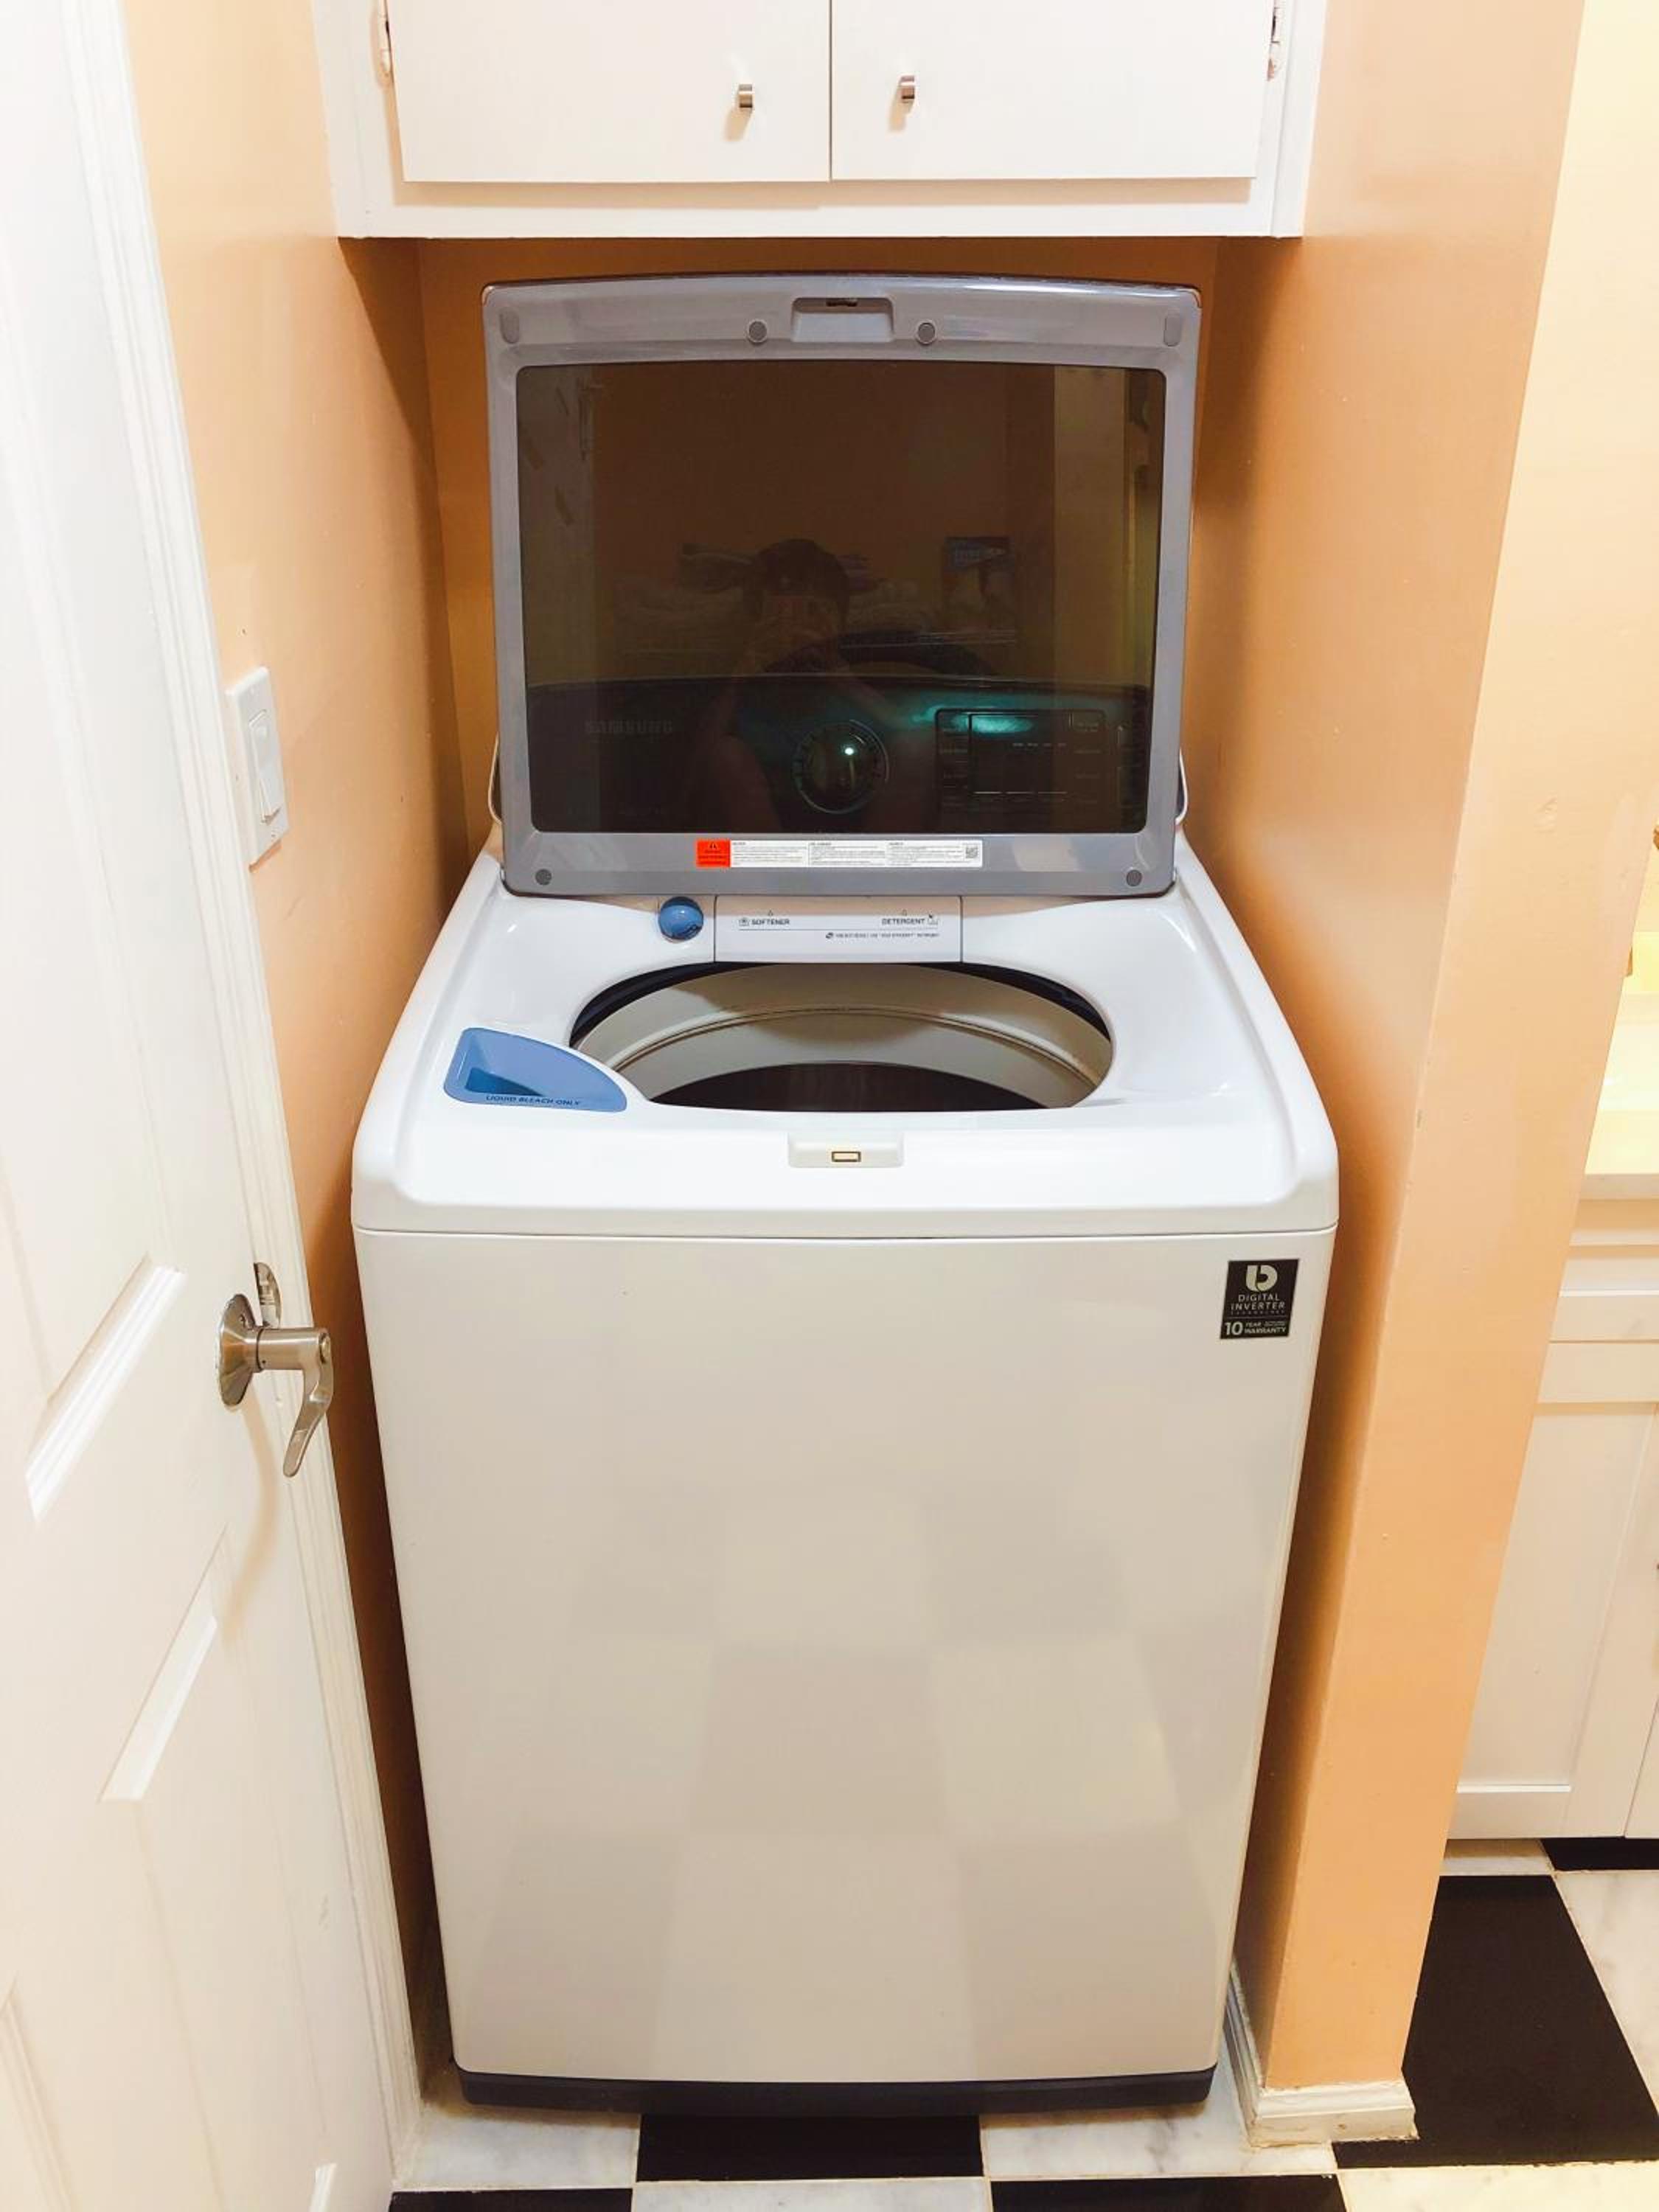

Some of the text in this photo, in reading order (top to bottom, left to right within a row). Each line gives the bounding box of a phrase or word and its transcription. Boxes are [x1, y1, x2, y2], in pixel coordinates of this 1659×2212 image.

[518, 1096, 554, 1105] BLEACH
[1238, 1293, 1281, 1302] DIGITAL
[1231, 1301, 1285, 1310] INVERTER
[1225, 1321, 1244, 1336] 10
[1244, 1326, 1287, 1335] WARRANTY
